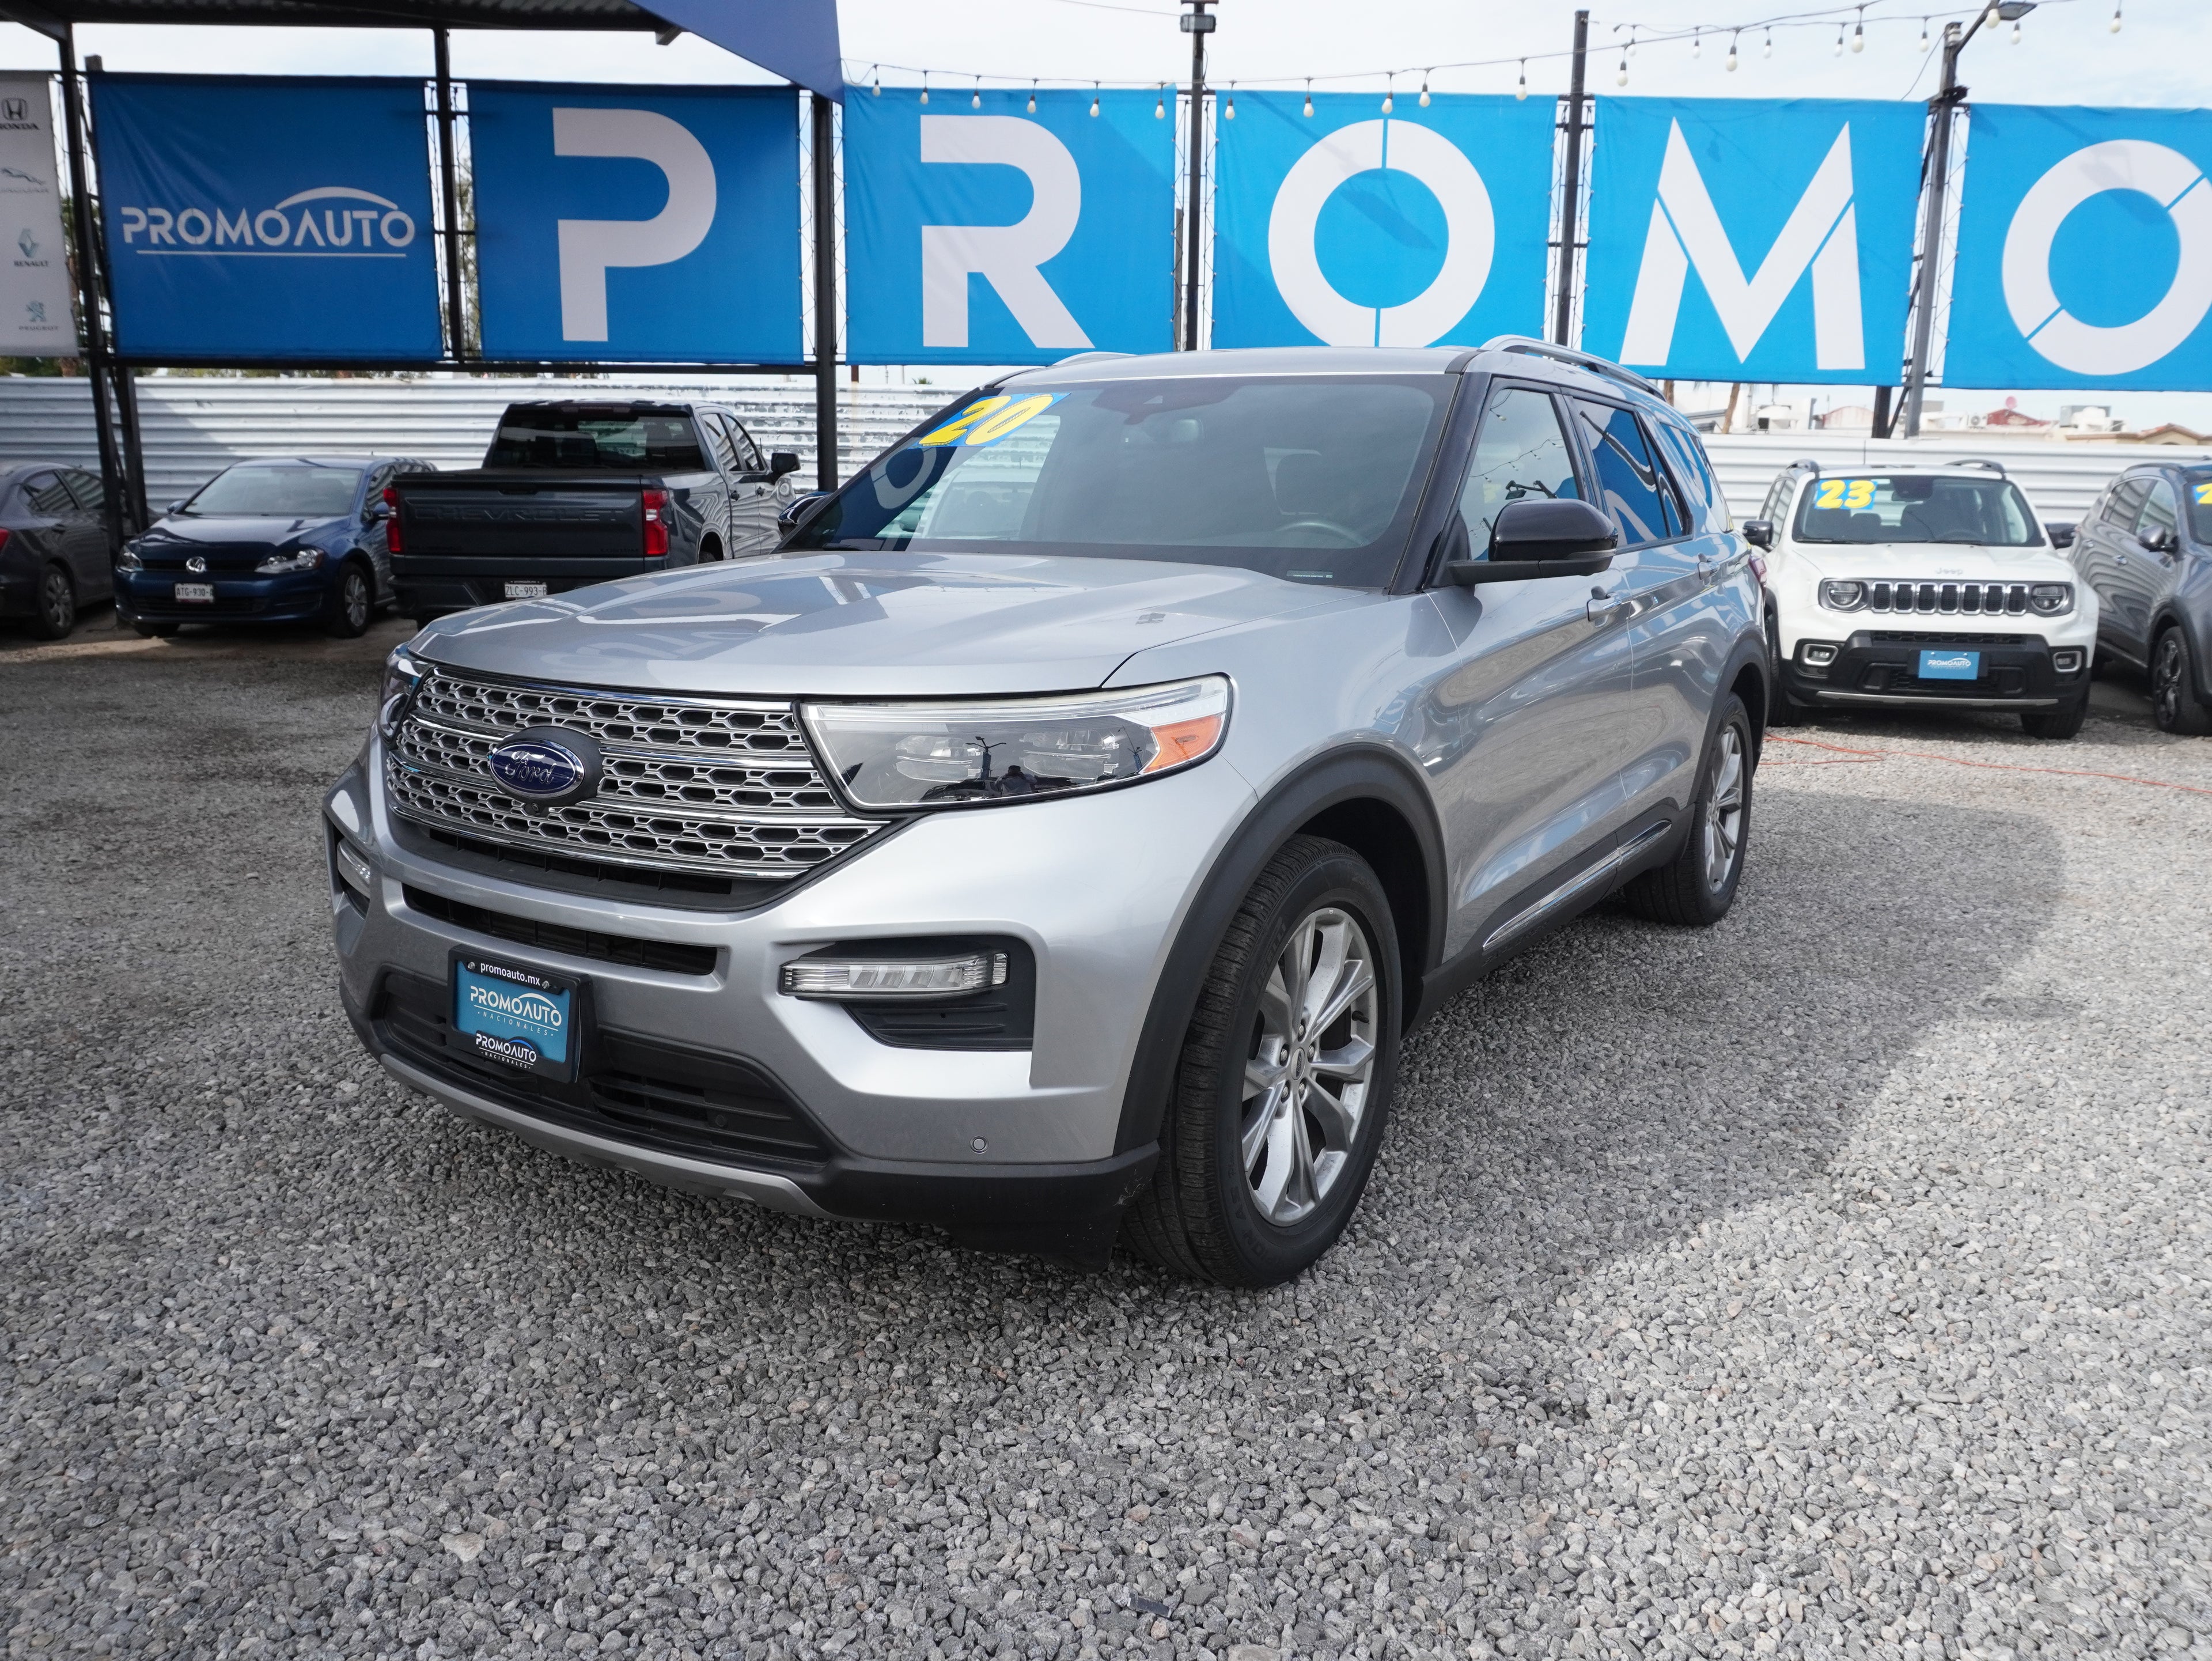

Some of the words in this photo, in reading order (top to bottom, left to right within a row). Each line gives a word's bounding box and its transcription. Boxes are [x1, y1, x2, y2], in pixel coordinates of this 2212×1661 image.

[120, 206, 416, 247] PROMOAUTO
[918, 394, 1054, 447] 20
[1816, 479, 1876, 509] 23
[415, 507, 624, 521] CHEVROLET
[1934, 567, 1964, 576] Jeep
[504, 750, 557, 785] Ford
[480, 963, 540, 986] promoauto.mx
[470, 985, 562, 1027] PROMOAUTO
[483, 1011, 548, 1036] NACIONALES
[476, 1033, 537, 1062] PROMOAUTO
[484, 1051, 527, 1069] NACIONALES
